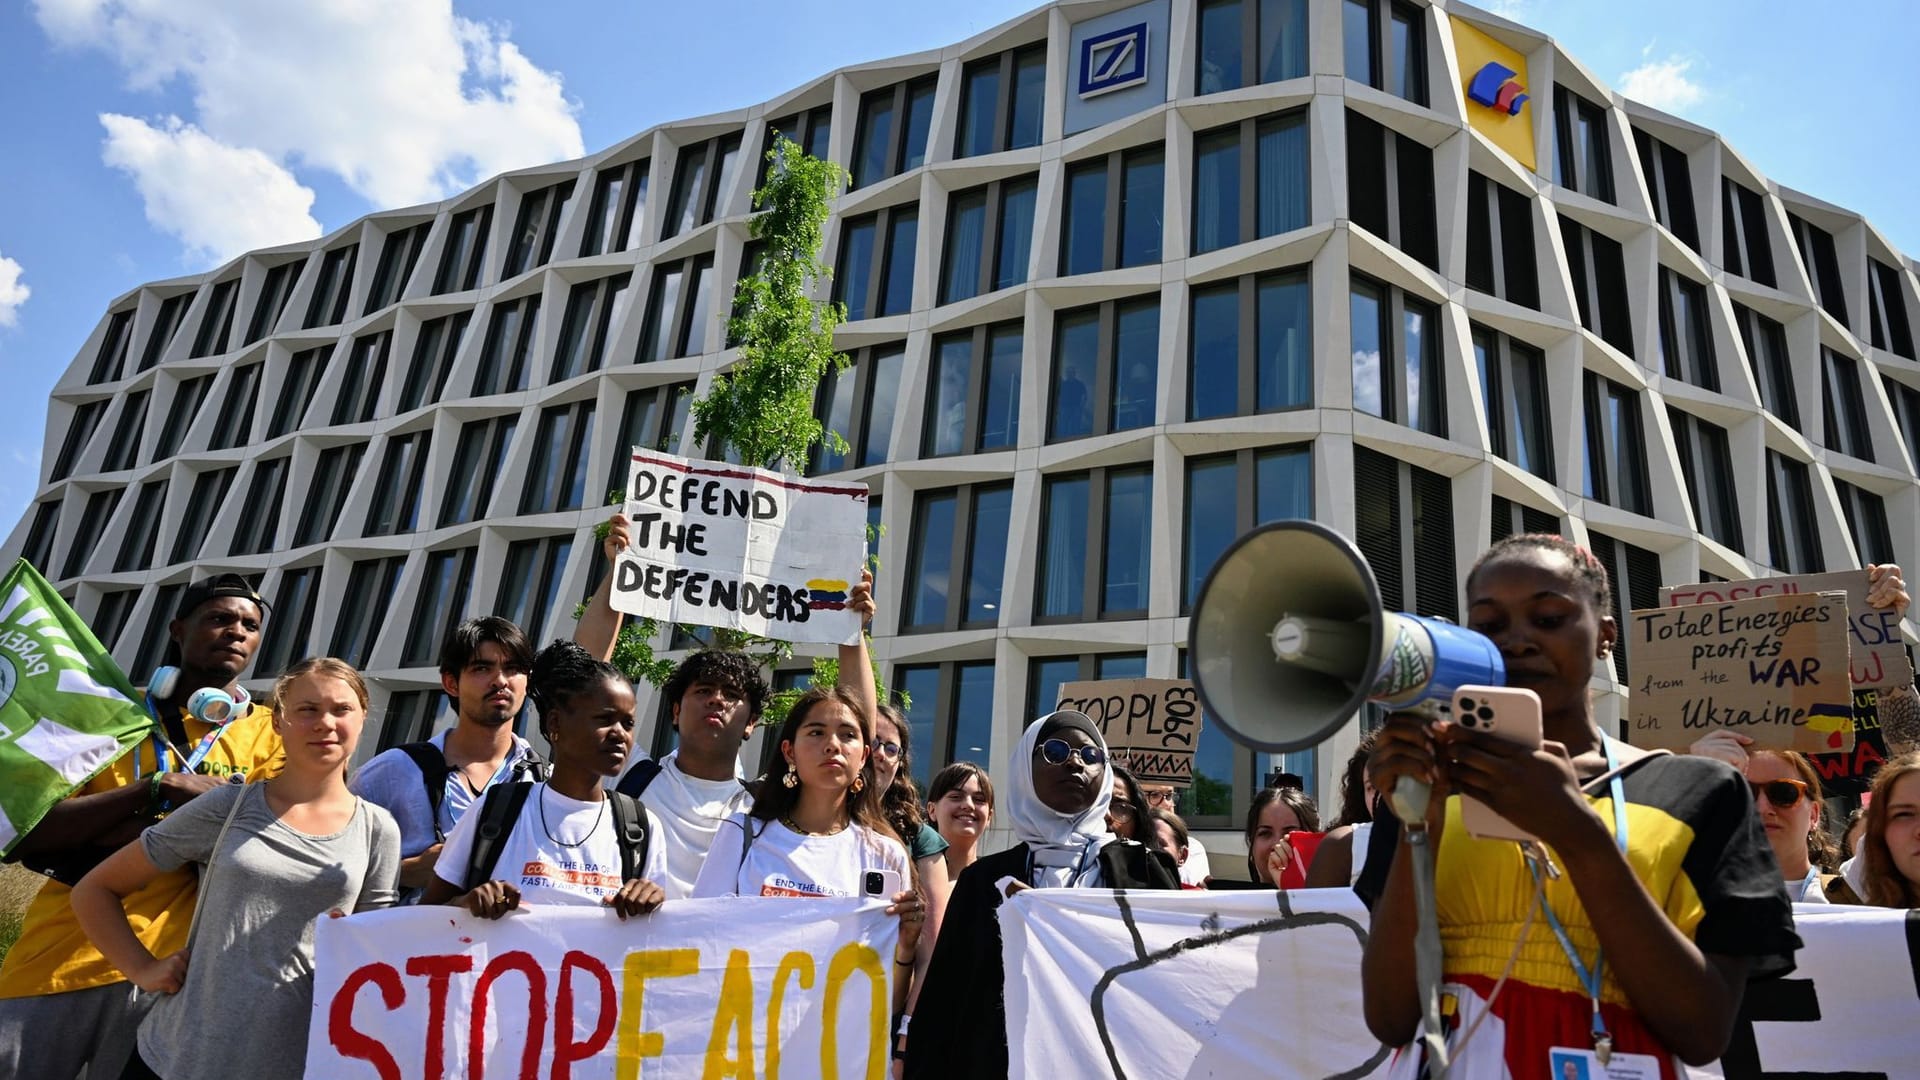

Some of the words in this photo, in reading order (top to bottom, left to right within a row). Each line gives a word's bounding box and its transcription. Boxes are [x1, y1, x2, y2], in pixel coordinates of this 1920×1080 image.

[634, 470, 778, 520] DEFEND
[632, 512, 708, 557] THE
[616, 559, 810, 623] DEFENDERS
[1691, 635, 1783, 671] profits
[1640, 674, 1684, 696] from
[1700, 669, 1729, 685] the
[1749, 656, 1822, 688] WAR
[1636, 712, 1662, 731] in
[1681, 695, 1810, 729] Ukraine
[775, 878, 796, 889] END
[797, 882, 816, 893] THE
[817, 885, 835, 897] ERA
